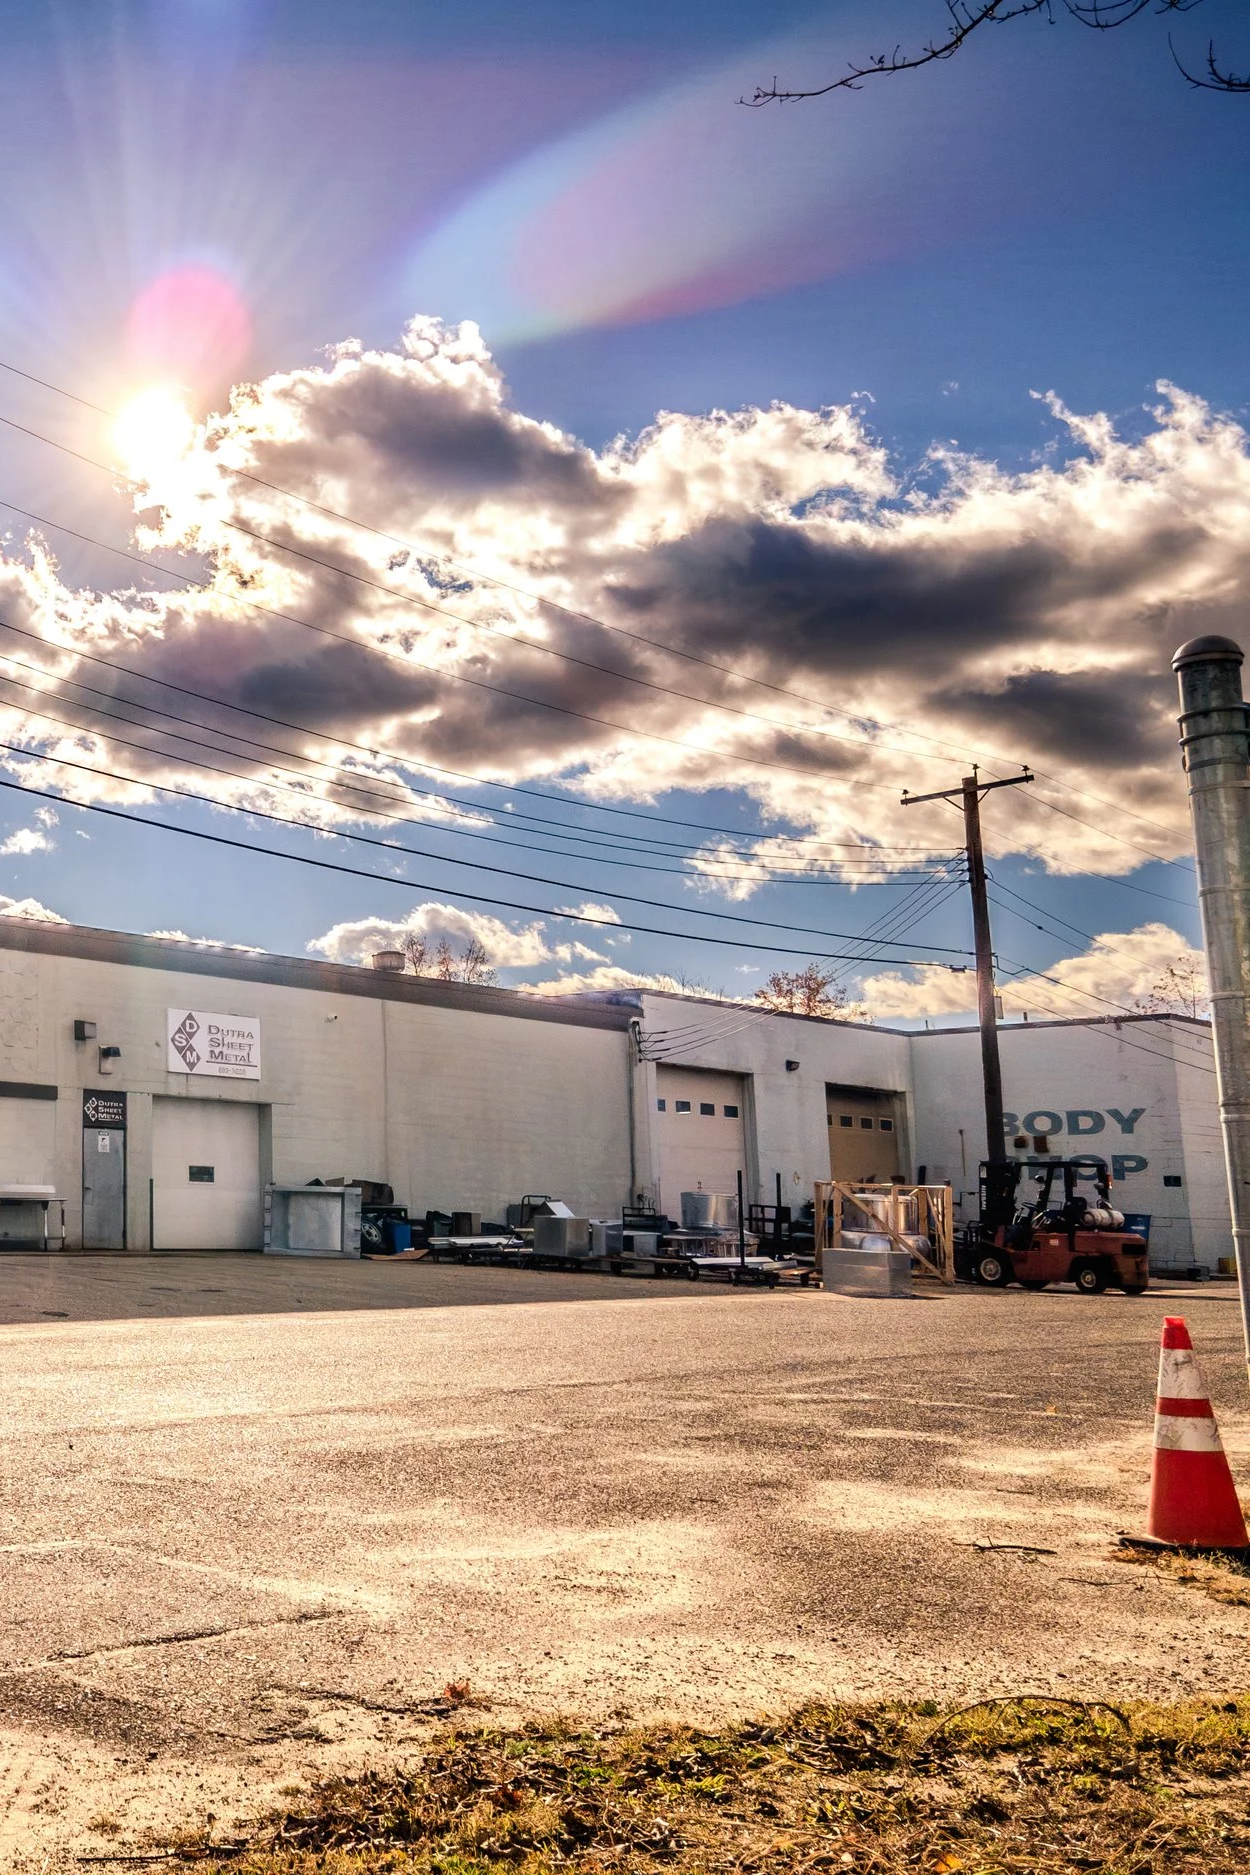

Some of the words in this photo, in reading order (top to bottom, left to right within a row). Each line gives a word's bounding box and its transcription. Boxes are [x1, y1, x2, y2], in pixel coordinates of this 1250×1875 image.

[185, 1020, 198, 1033] D
[207, 1024, 254, 1039] DUTRA
[174, 1033, 187, 1047] S
[208, 1037, 254, 1051] SHEET
[186, 1050, 197, 1063] M
[210, 1050, 252, 1063] METAL
[1002, 1107, 1147, 1136] BODY
[1006, 1154, 1149, 1181] HOP
